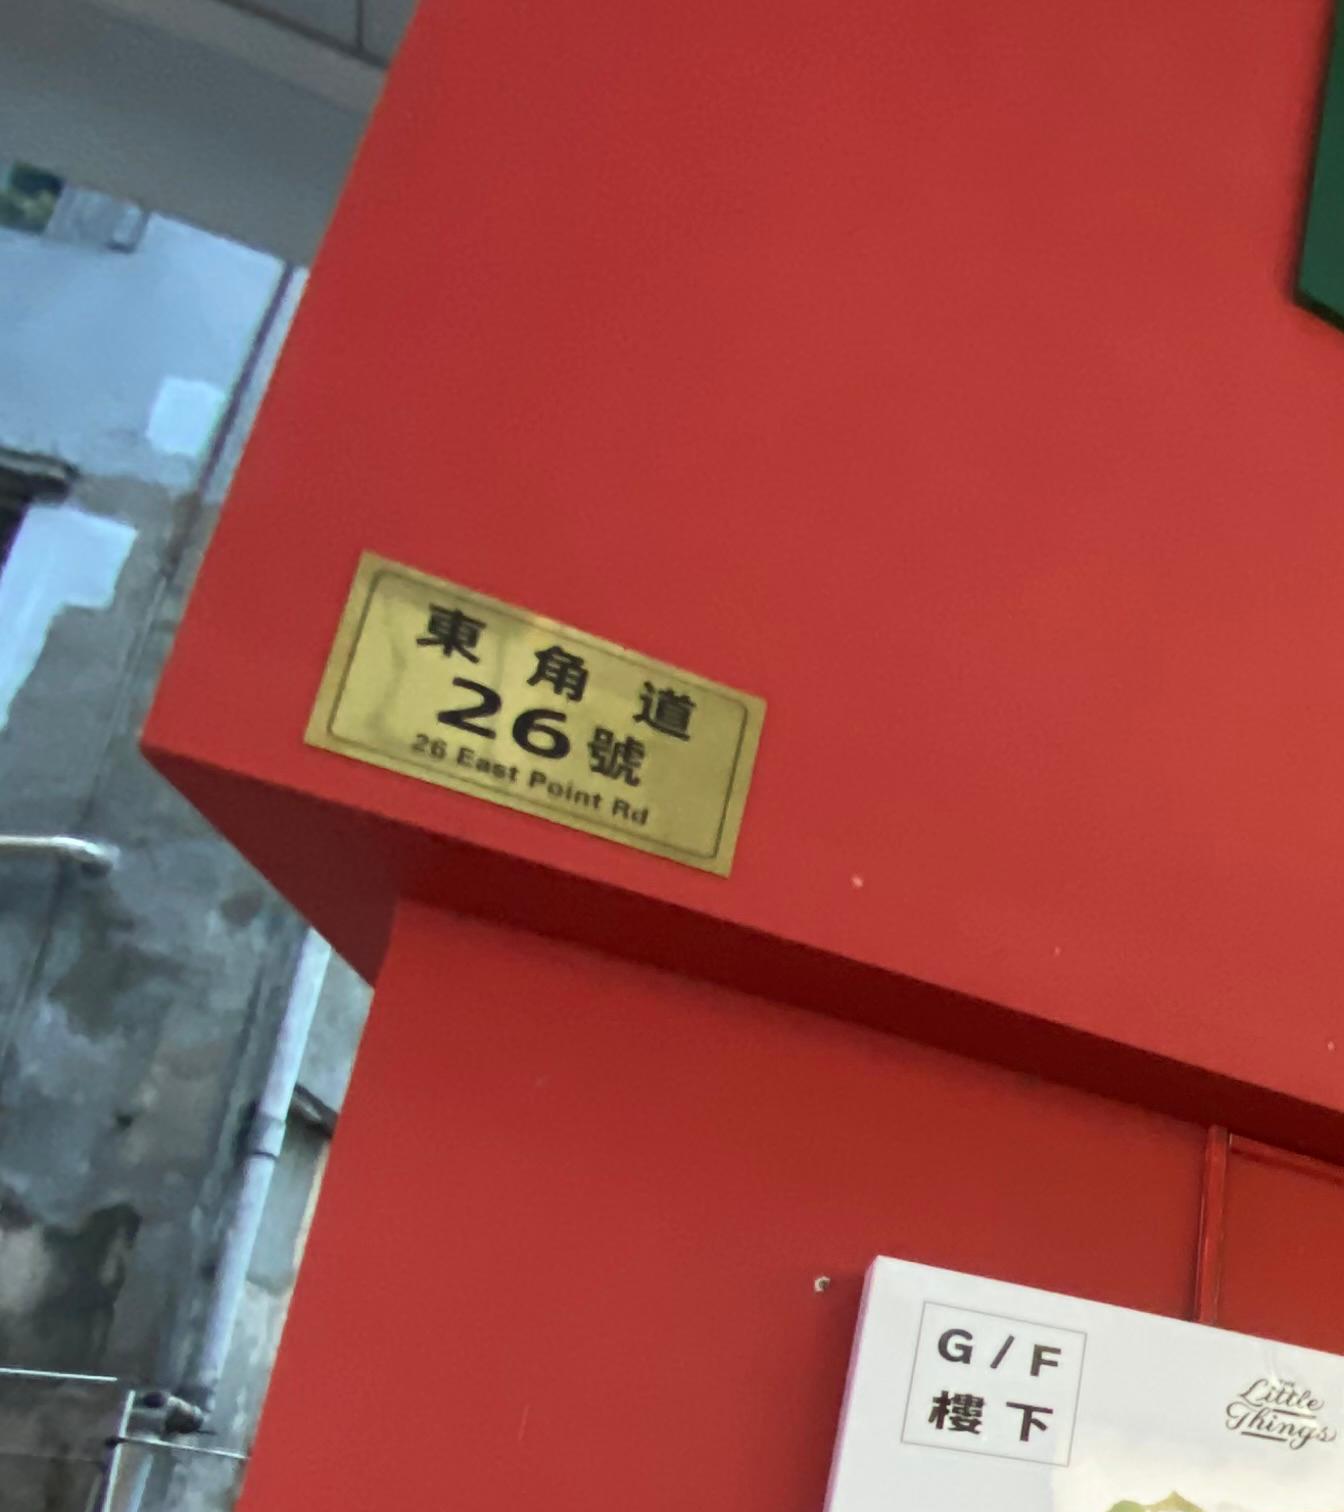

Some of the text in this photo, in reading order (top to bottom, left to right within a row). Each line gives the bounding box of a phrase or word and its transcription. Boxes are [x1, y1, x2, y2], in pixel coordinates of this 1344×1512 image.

[416, 602, 697, 742] 東角道
[437, 676, 646, 788] 26號
[410, 733, 650, 828] 26 East Point Rd
[927, 1389, 1055, 1443] 樓下
[1225, 1401, 1337, 1450] Things
[1238, 1378, 1325, 1411] Little
